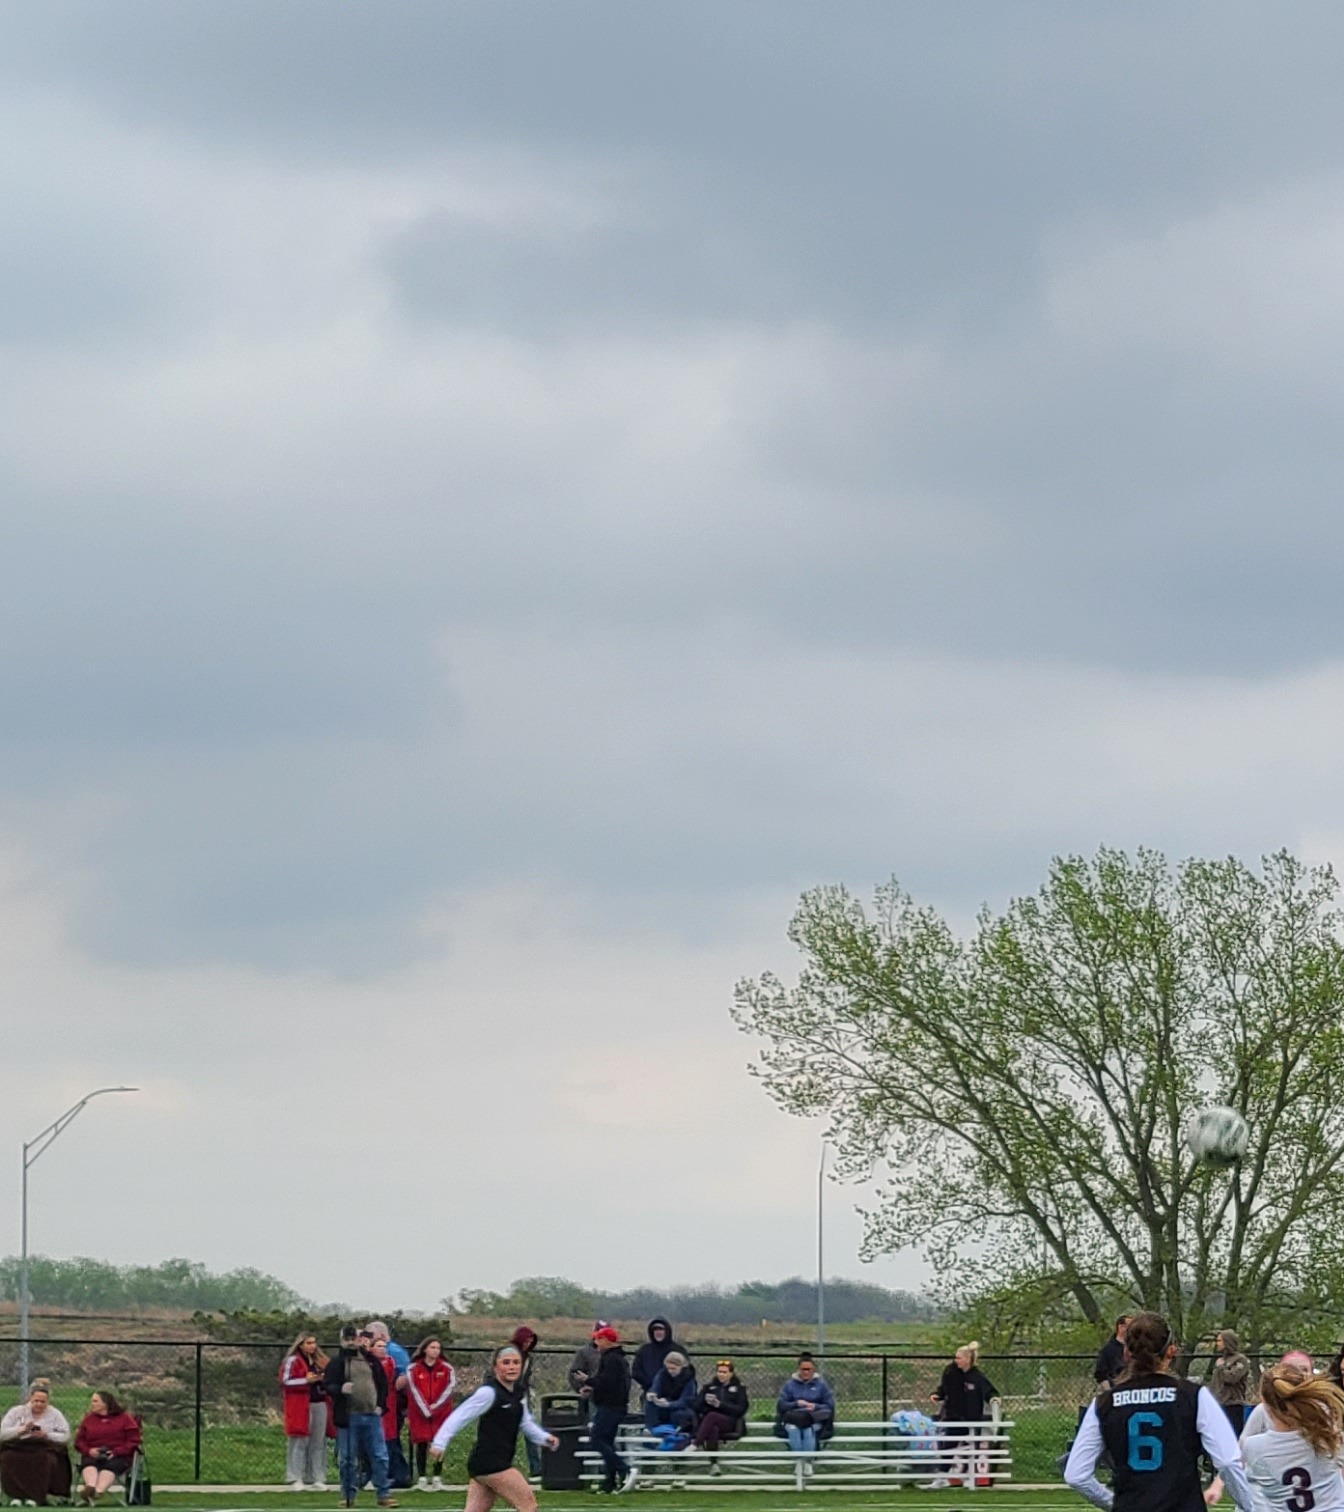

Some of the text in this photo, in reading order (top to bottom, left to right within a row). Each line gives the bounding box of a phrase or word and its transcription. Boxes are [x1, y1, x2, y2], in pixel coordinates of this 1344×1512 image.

[1112, 1387, 1177, 1407] BRONCOS
[1127, 1411, 1163, 1471] 6
[1282, 1467, 1315, 1512] 3
